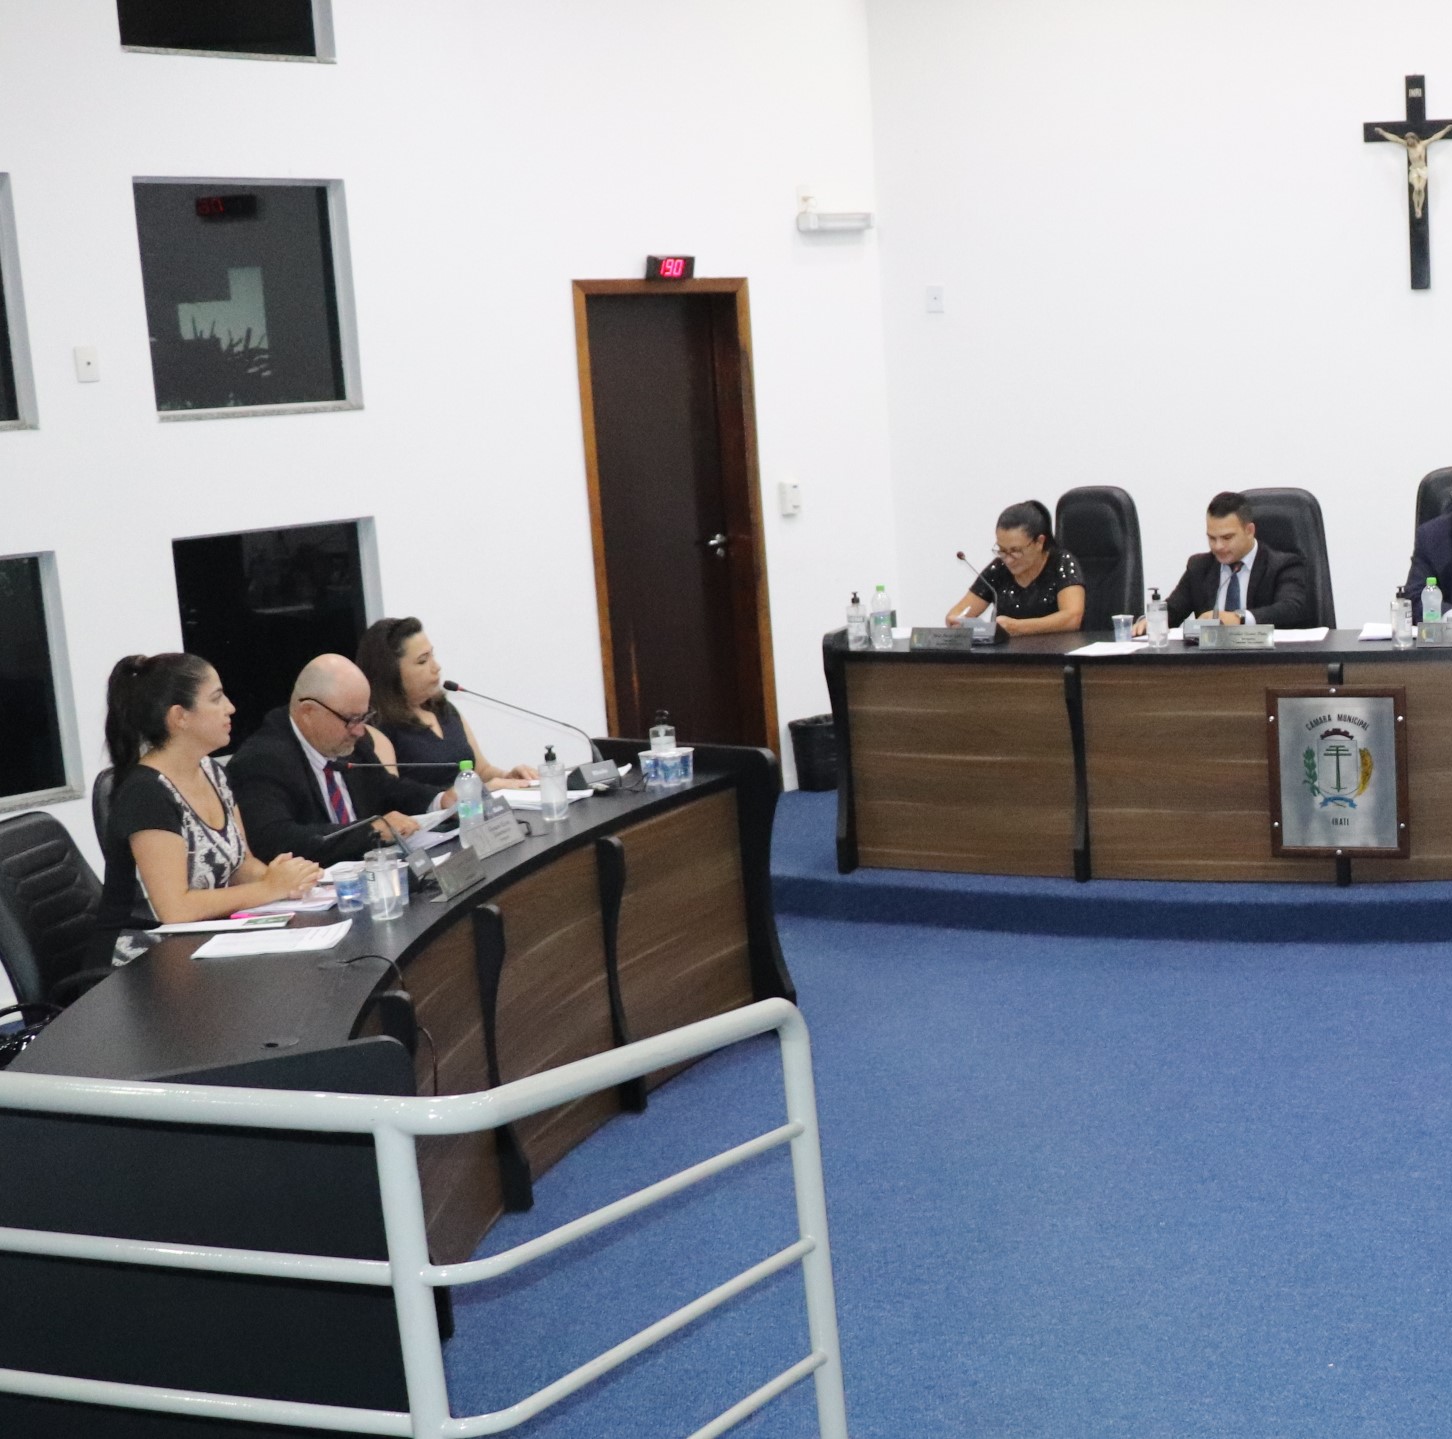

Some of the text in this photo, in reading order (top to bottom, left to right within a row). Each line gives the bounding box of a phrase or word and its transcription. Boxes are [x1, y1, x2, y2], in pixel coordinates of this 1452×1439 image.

[660, 258, 683, 277] 190
[1337, 713, 1369, 731] MUNICIPAL
[1332, 817, 1349, 825] IRATI
